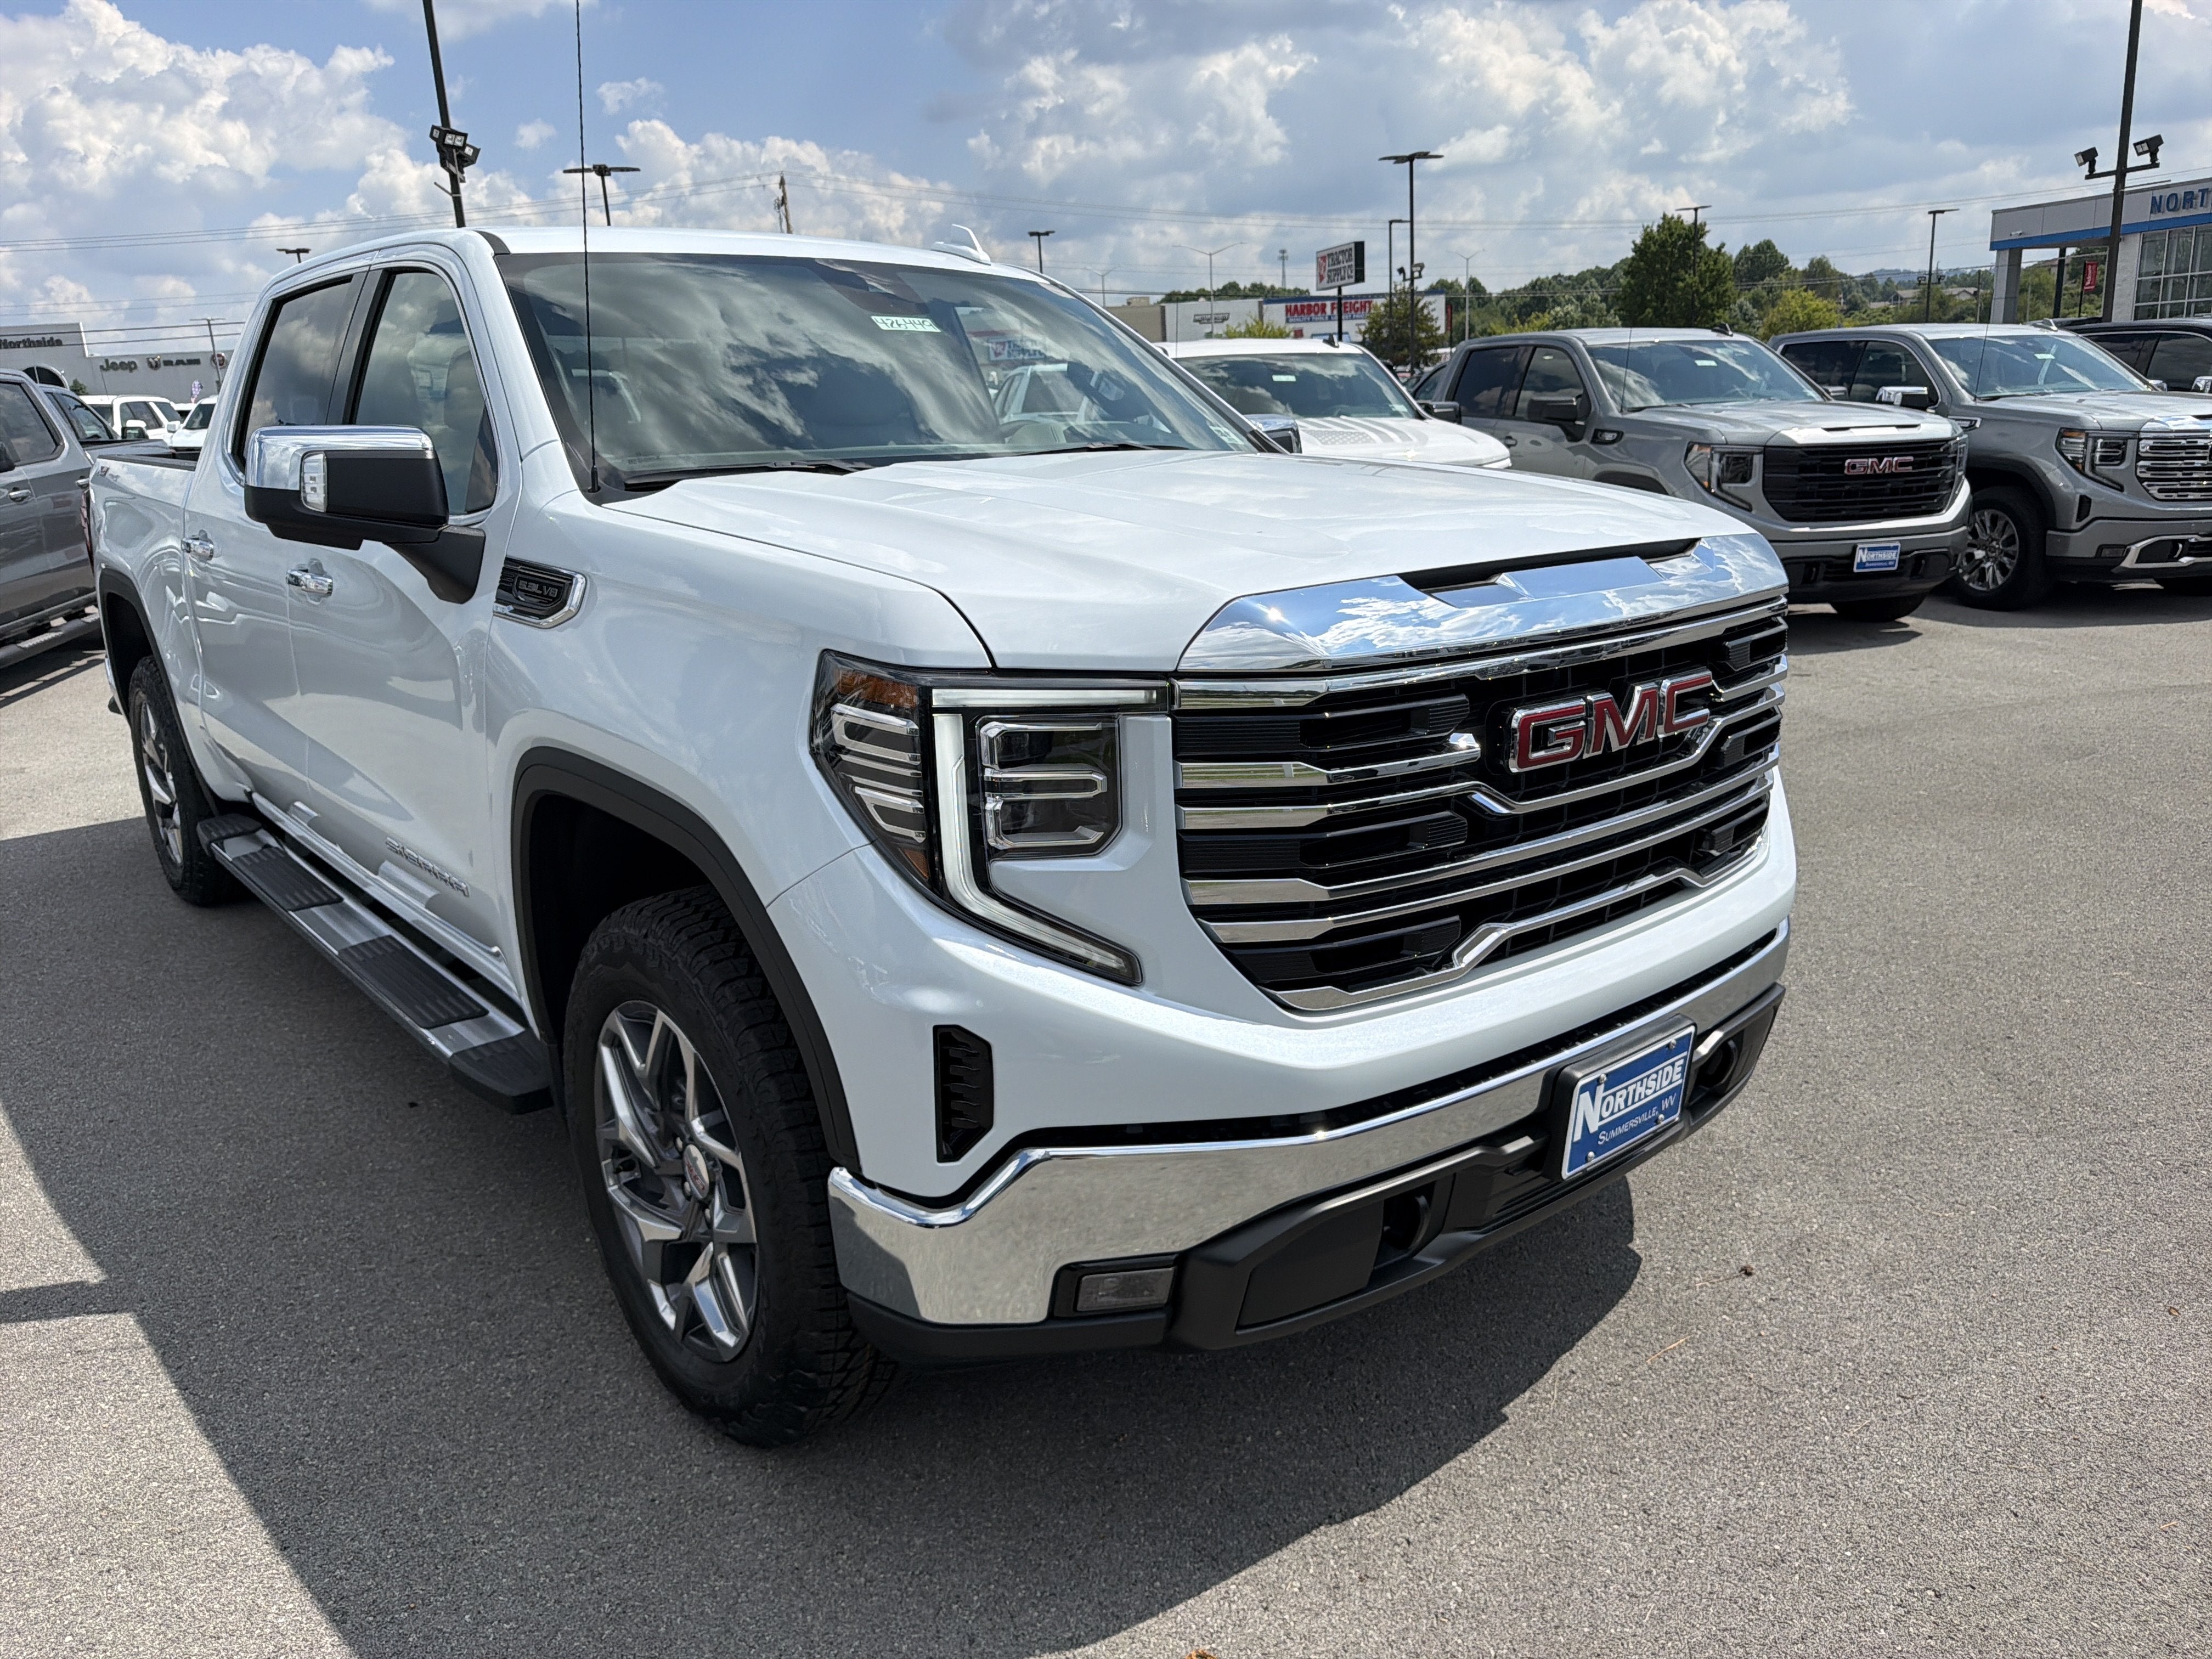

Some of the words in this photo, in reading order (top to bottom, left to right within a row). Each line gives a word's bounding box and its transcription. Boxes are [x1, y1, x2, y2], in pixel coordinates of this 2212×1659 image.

[2150, 188, 2212, 214] NORT
[1327, 247, 1352, 267] TRACTOR
[1327, 266, 1346, 283] SUPPLY
[1285, 303, 1327, 317] HARBOR
[1330, 300, 1373, 315] FEIGHT
[0, 336, 63, 349] Northside
[99, 358, 138, 373] Jeep
[163, 358, 201, 366] RAM
[1844, 456, 1914, 475] GMC
[1509, 666, 1713, 772] GMC
[1661, 1092, 1677, 1111] WV
